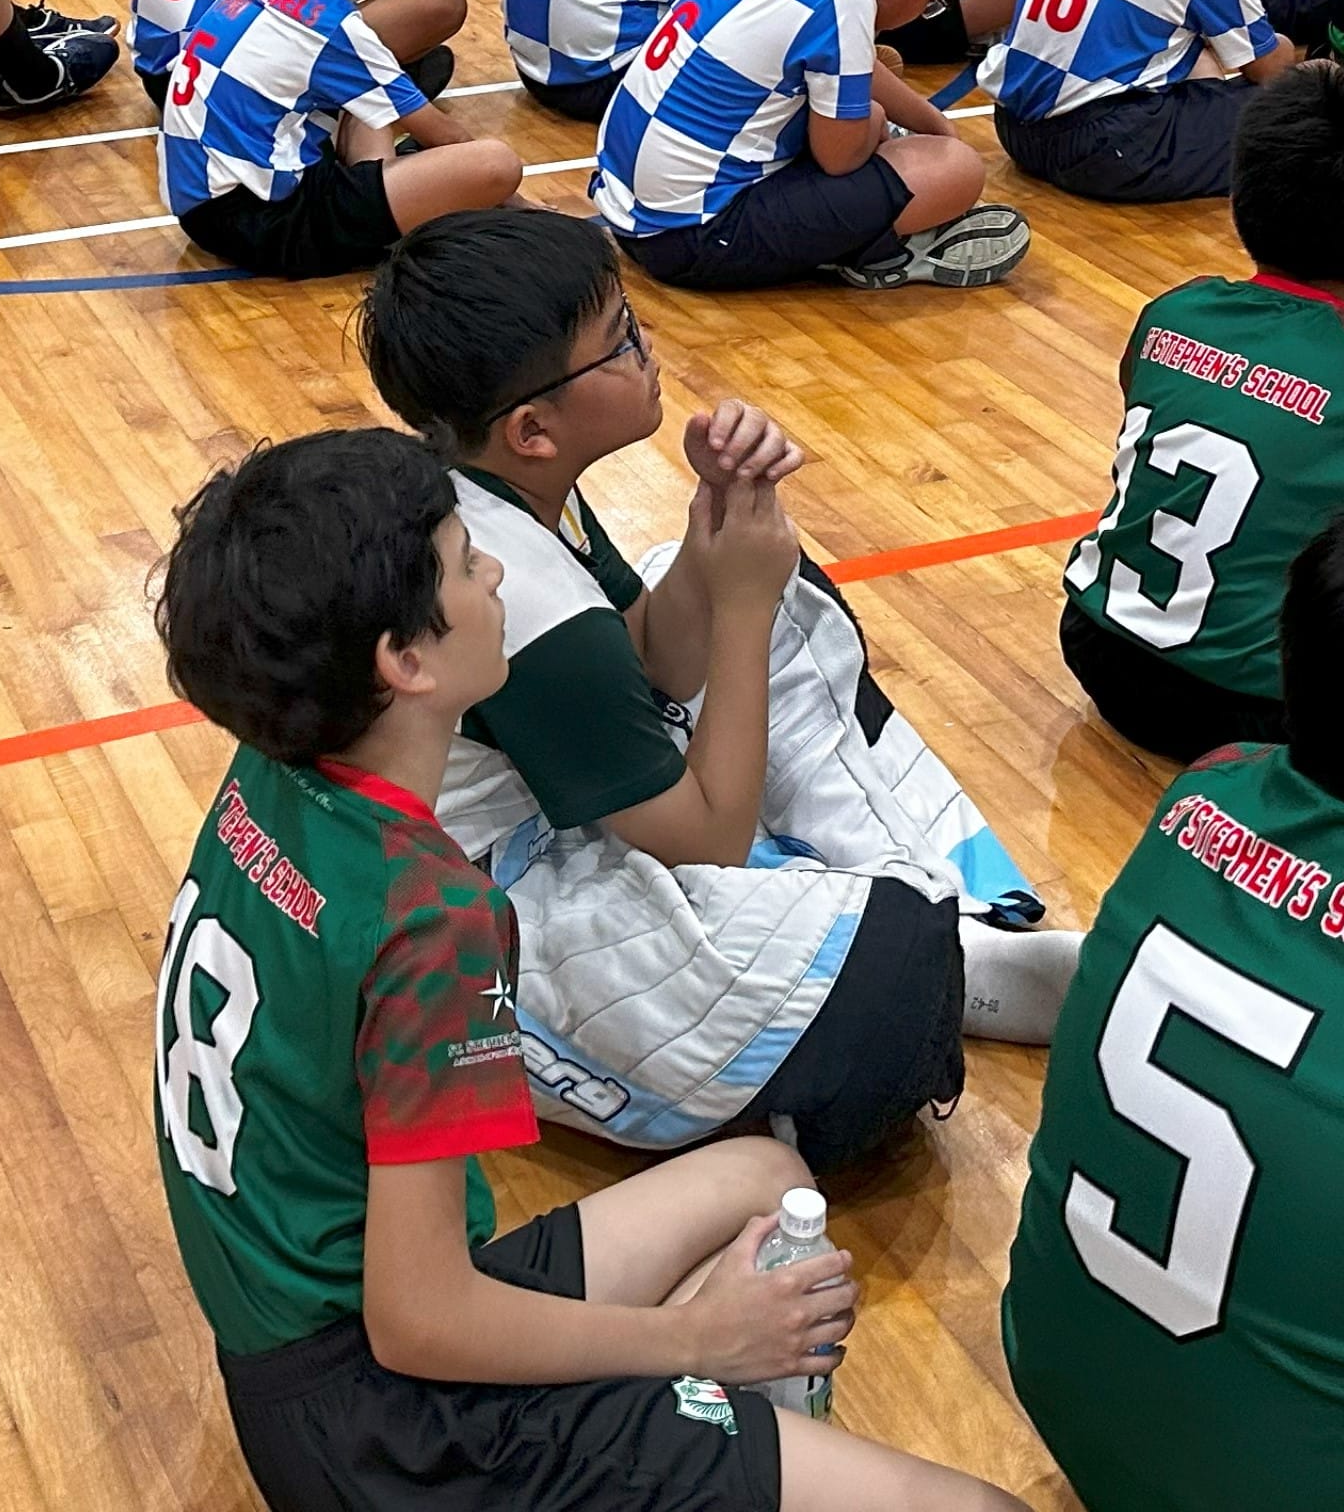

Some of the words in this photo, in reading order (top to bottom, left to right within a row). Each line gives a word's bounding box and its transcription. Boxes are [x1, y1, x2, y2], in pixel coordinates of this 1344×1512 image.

[171, 30, 217, 106] 5
[645, 0, 699, 71] 6
[1151, 330, 1249, 388] STEPHEN'S
[1241, 364, 1332, 425] SCHOOL
[1063, 403, 1264, 651] 13
[261, 858, 327, 939] SCHOOL
[1177, 800, 1331, 920] STEPHEN'S
[156, 878, 260, 1197] 18
[1064, 916, 1325, 1345] 5
